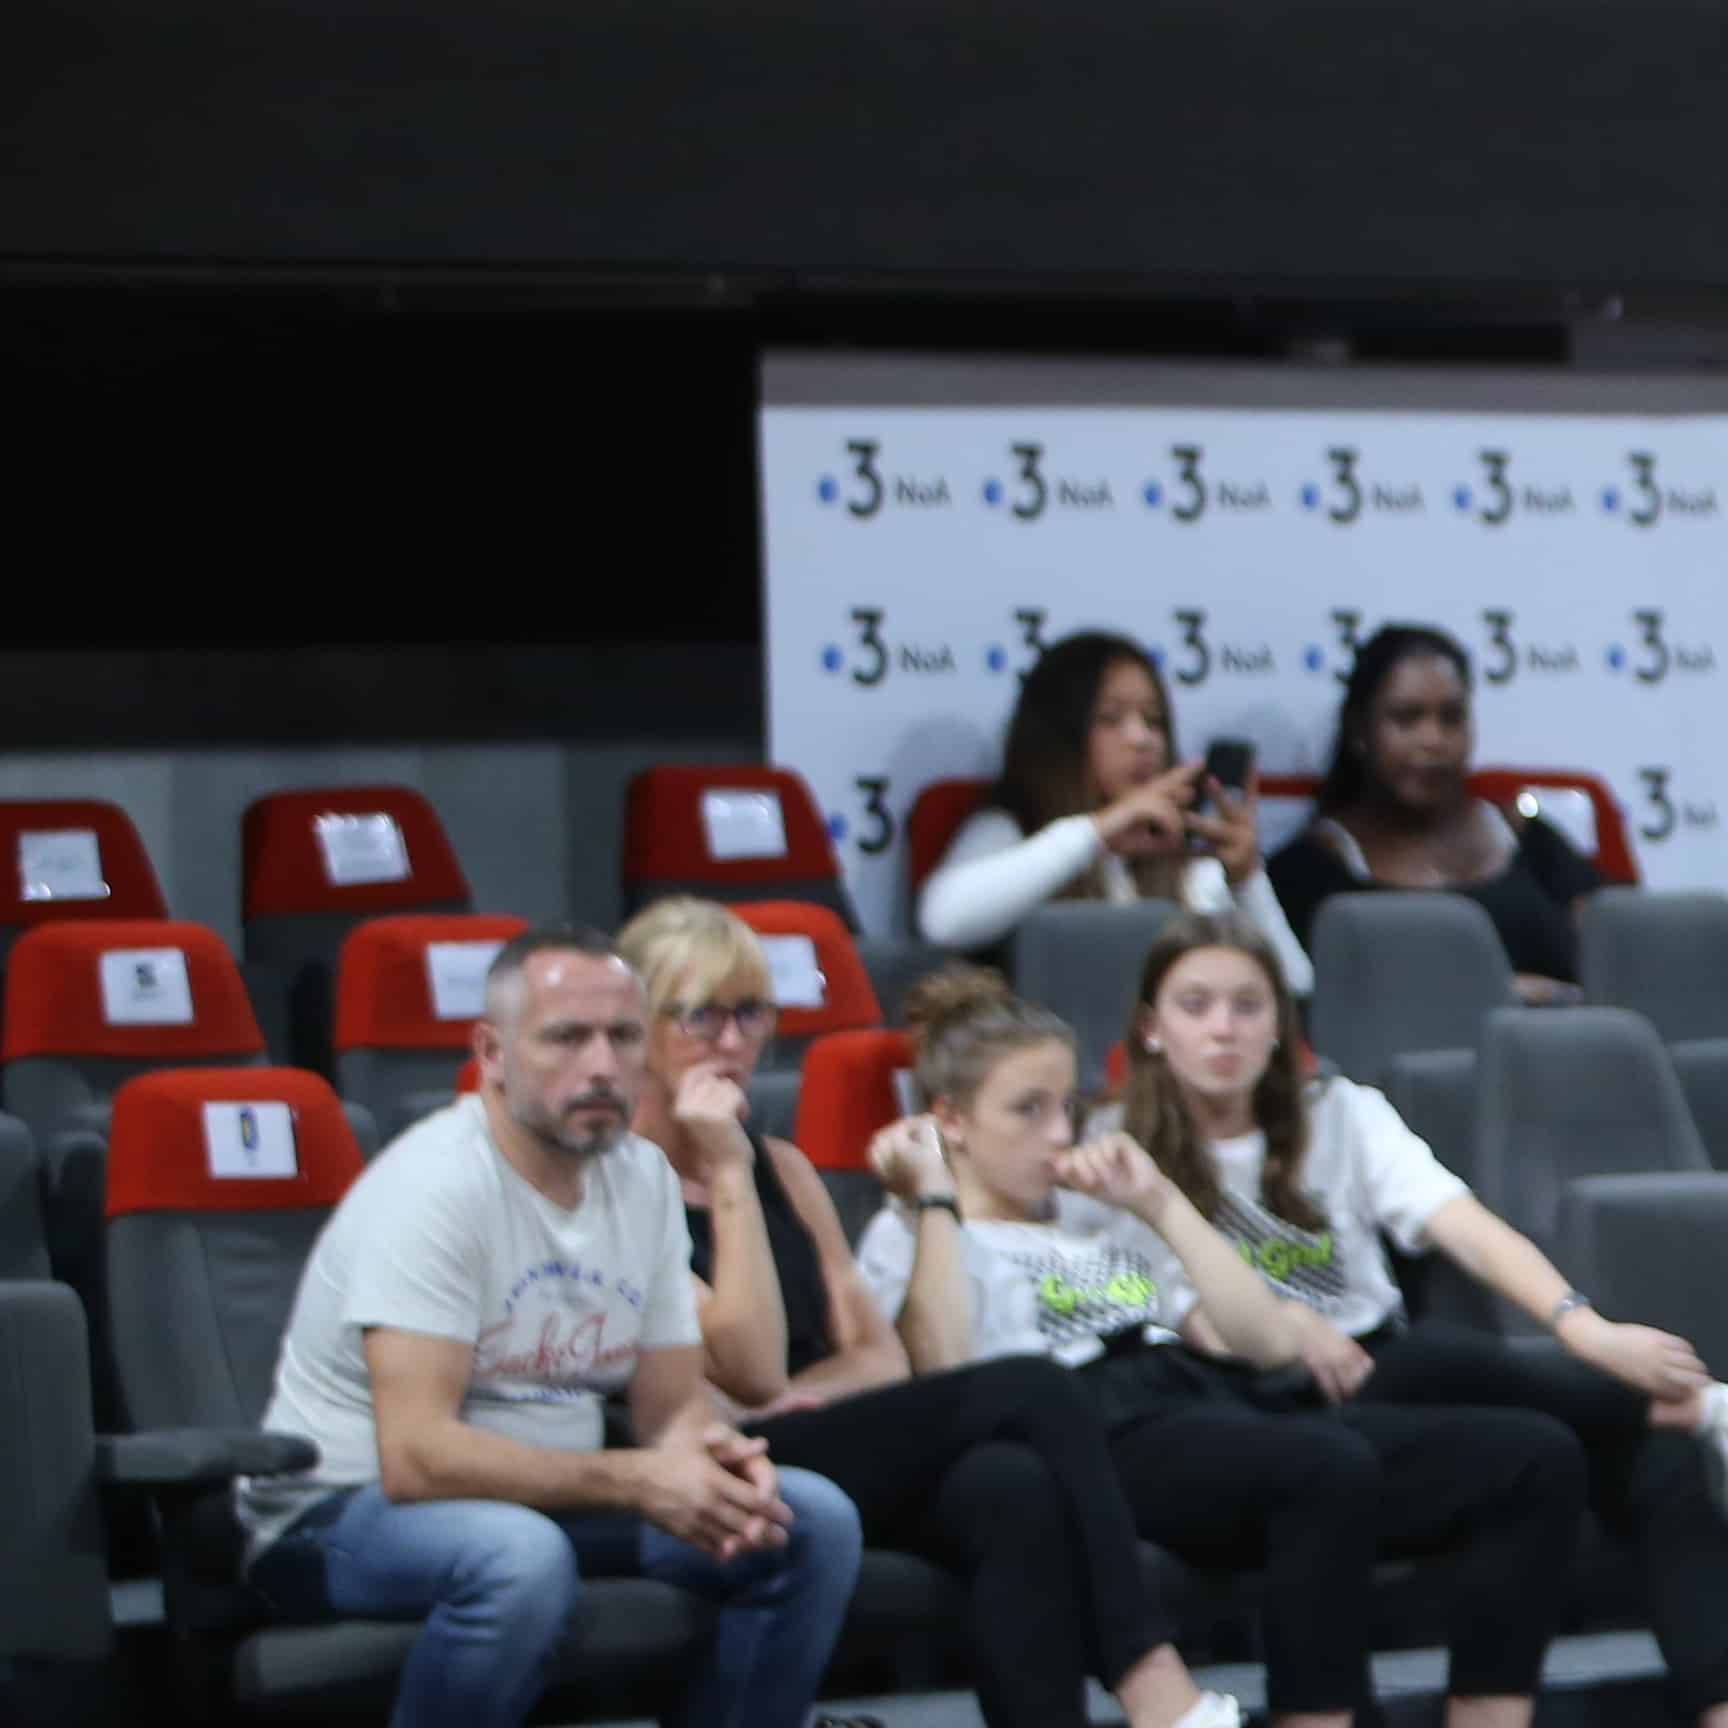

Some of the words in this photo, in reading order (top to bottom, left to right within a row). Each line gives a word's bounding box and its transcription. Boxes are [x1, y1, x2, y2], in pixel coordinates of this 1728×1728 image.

[846, 439, 884, 518] 3
[1011, 443, 1047, 520] 3
[1171, 445, 1207, 522] 3
[1327, 447, 1361, 525] 3
[1478, 449, 1513, 525] 3
[1629, 451, 1663, 526] 3
[850, 607, 888, 687] 3
[1173, 609, 1209, 686] 3
[1482, 609, 1517, 685] 3
[1634, 609, 1669, 685] 3
[854, 776, 894, 857] 3
[1638, 769, 1676, 843] 3
